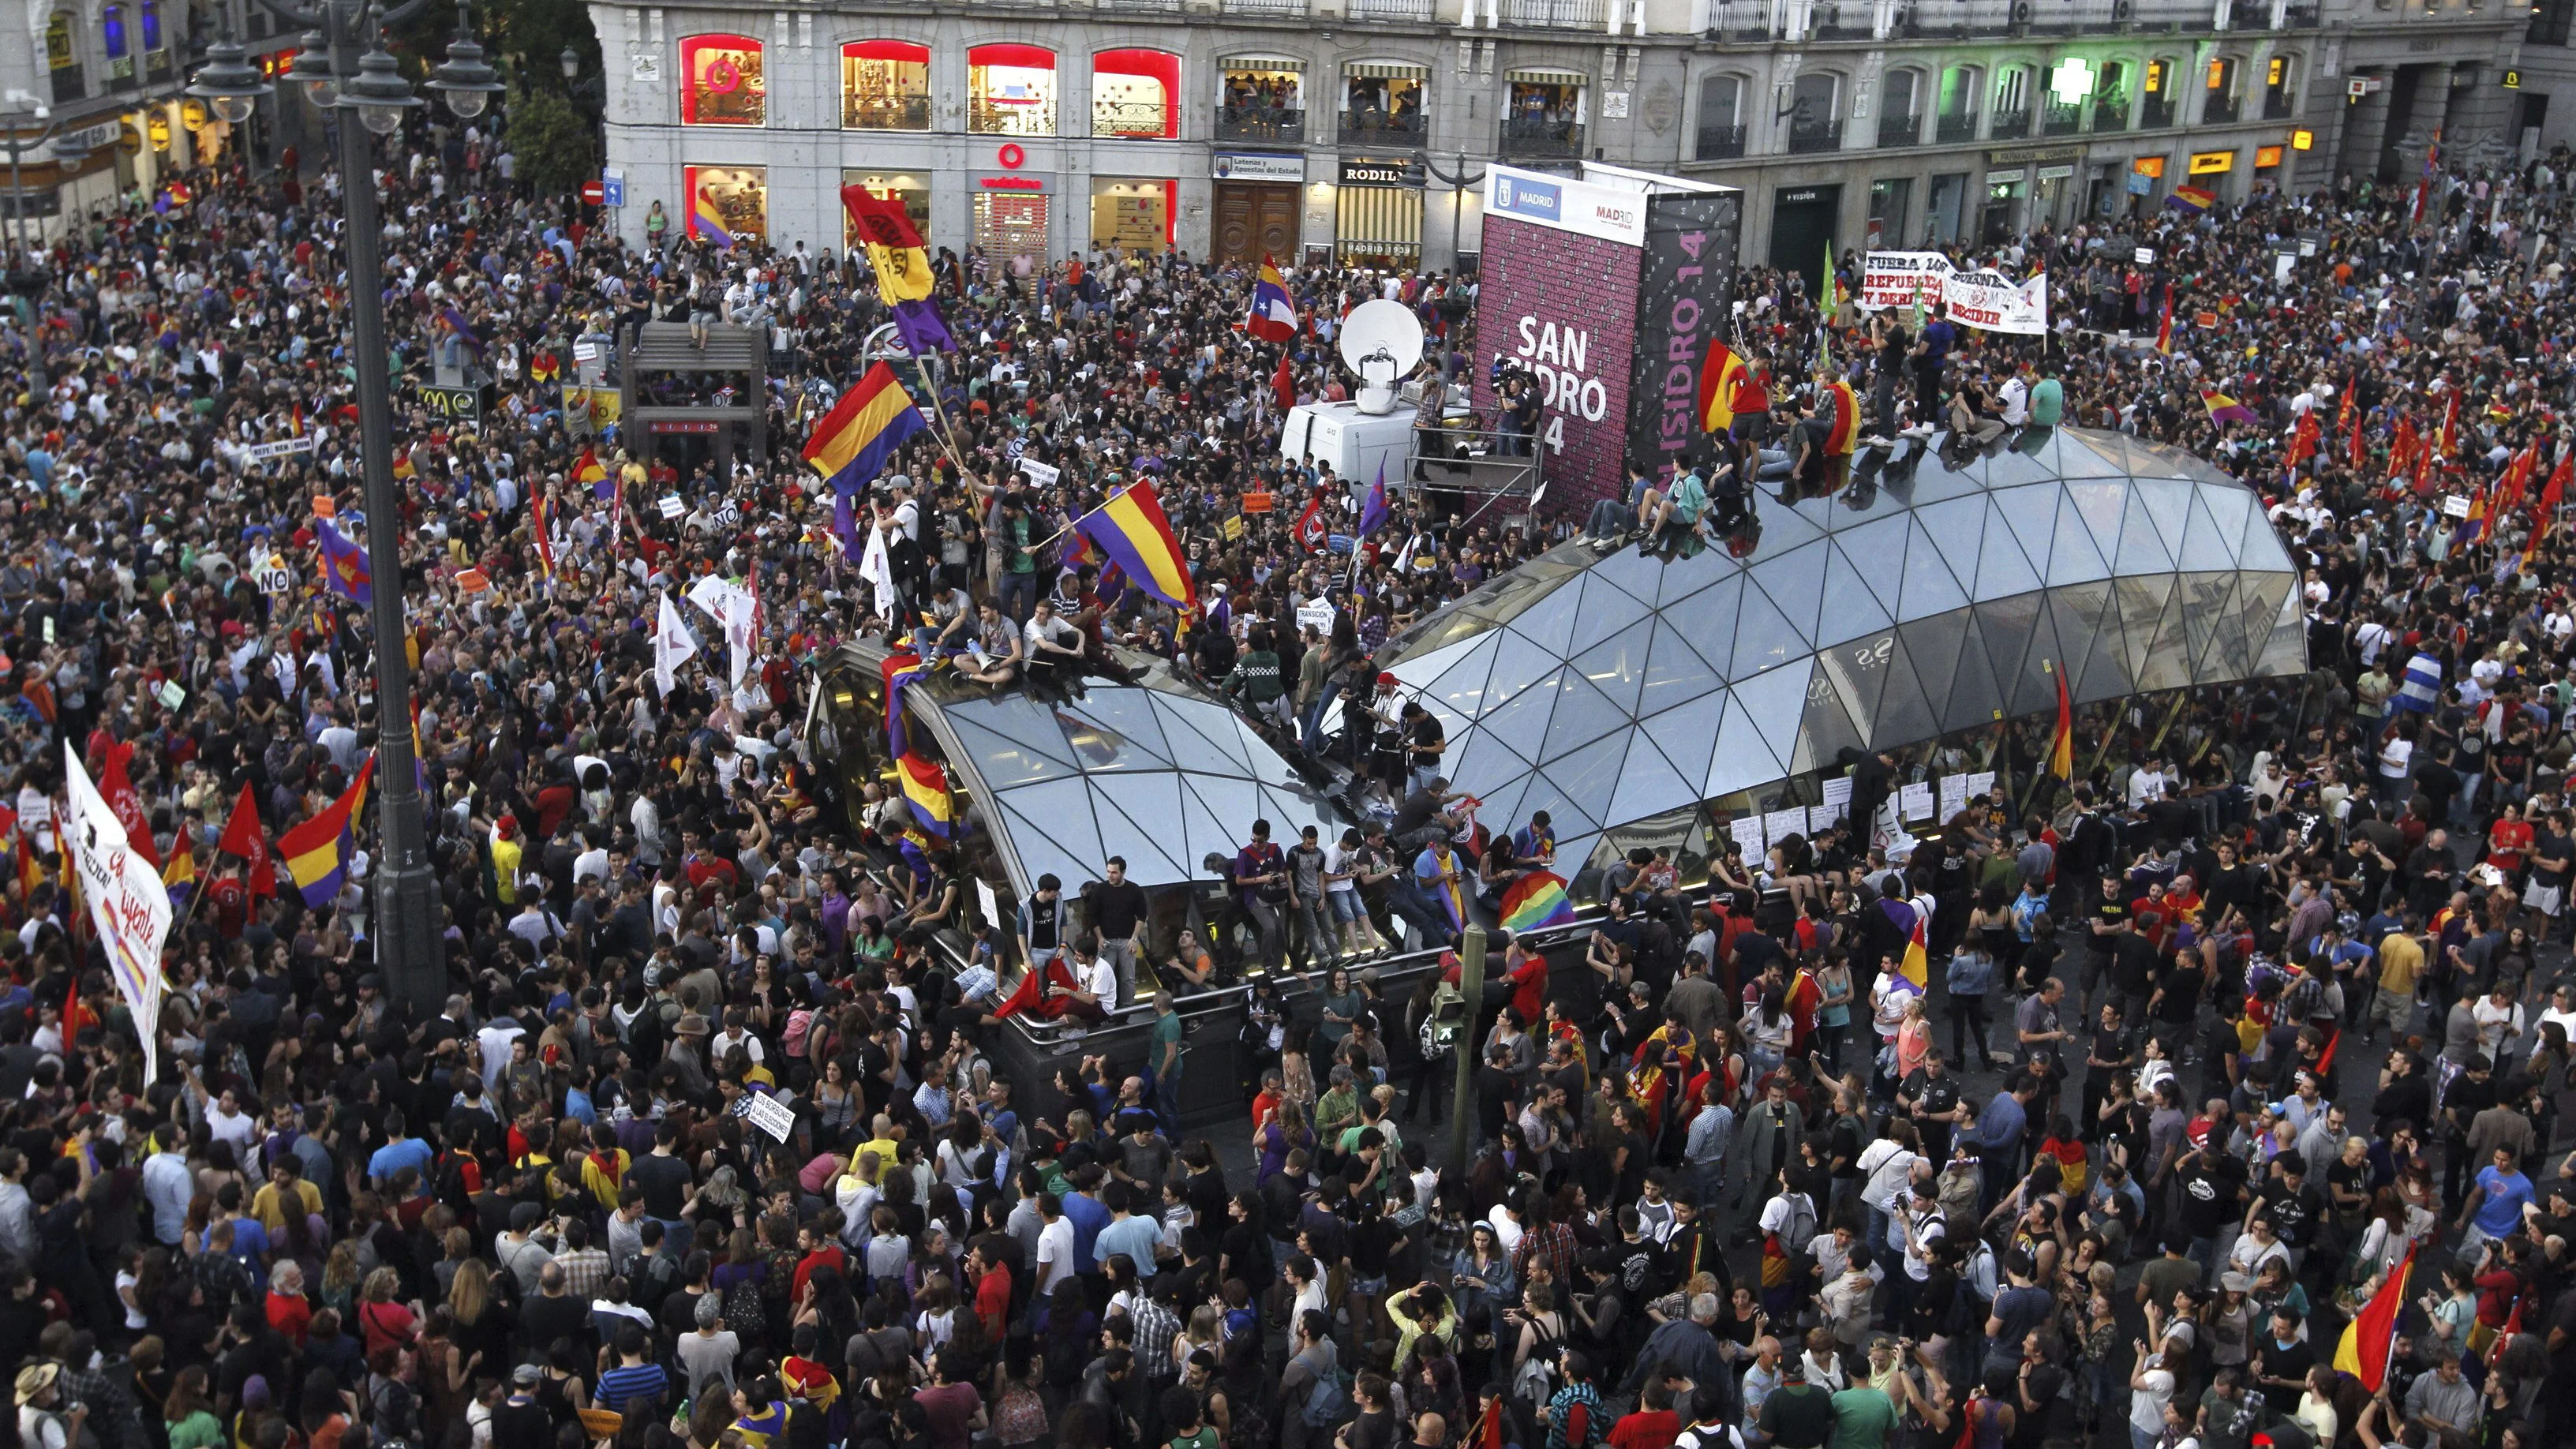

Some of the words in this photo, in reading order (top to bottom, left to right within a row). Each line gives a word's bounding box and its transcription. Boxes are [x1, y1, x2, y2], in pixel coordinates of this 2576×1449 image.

[1234, 166, 1264, 174] Apuestas
[979, 175, 1043, 190] vodafone
[1597, 205, 1634, 224] MADRID
[1347, 244, 1383, 253] MADRID
[1388, 245, 1410, 254] 1939
[1866, 256, 1920, 271] FUERA
[1863, 292, 1873, 305] Y
[1952, 301, 2001, 326] DECIDIR
[1518, 316, 1587, 372] SAN
[713, 507, 736, 528] NO
[260, 571, 287, 592] NO
[1298, 609, 1327, 619] TRANSICIÓN
[755, 1093, 766, 1106] LOS
[765, 1099, 792, 1123] BORBONES
